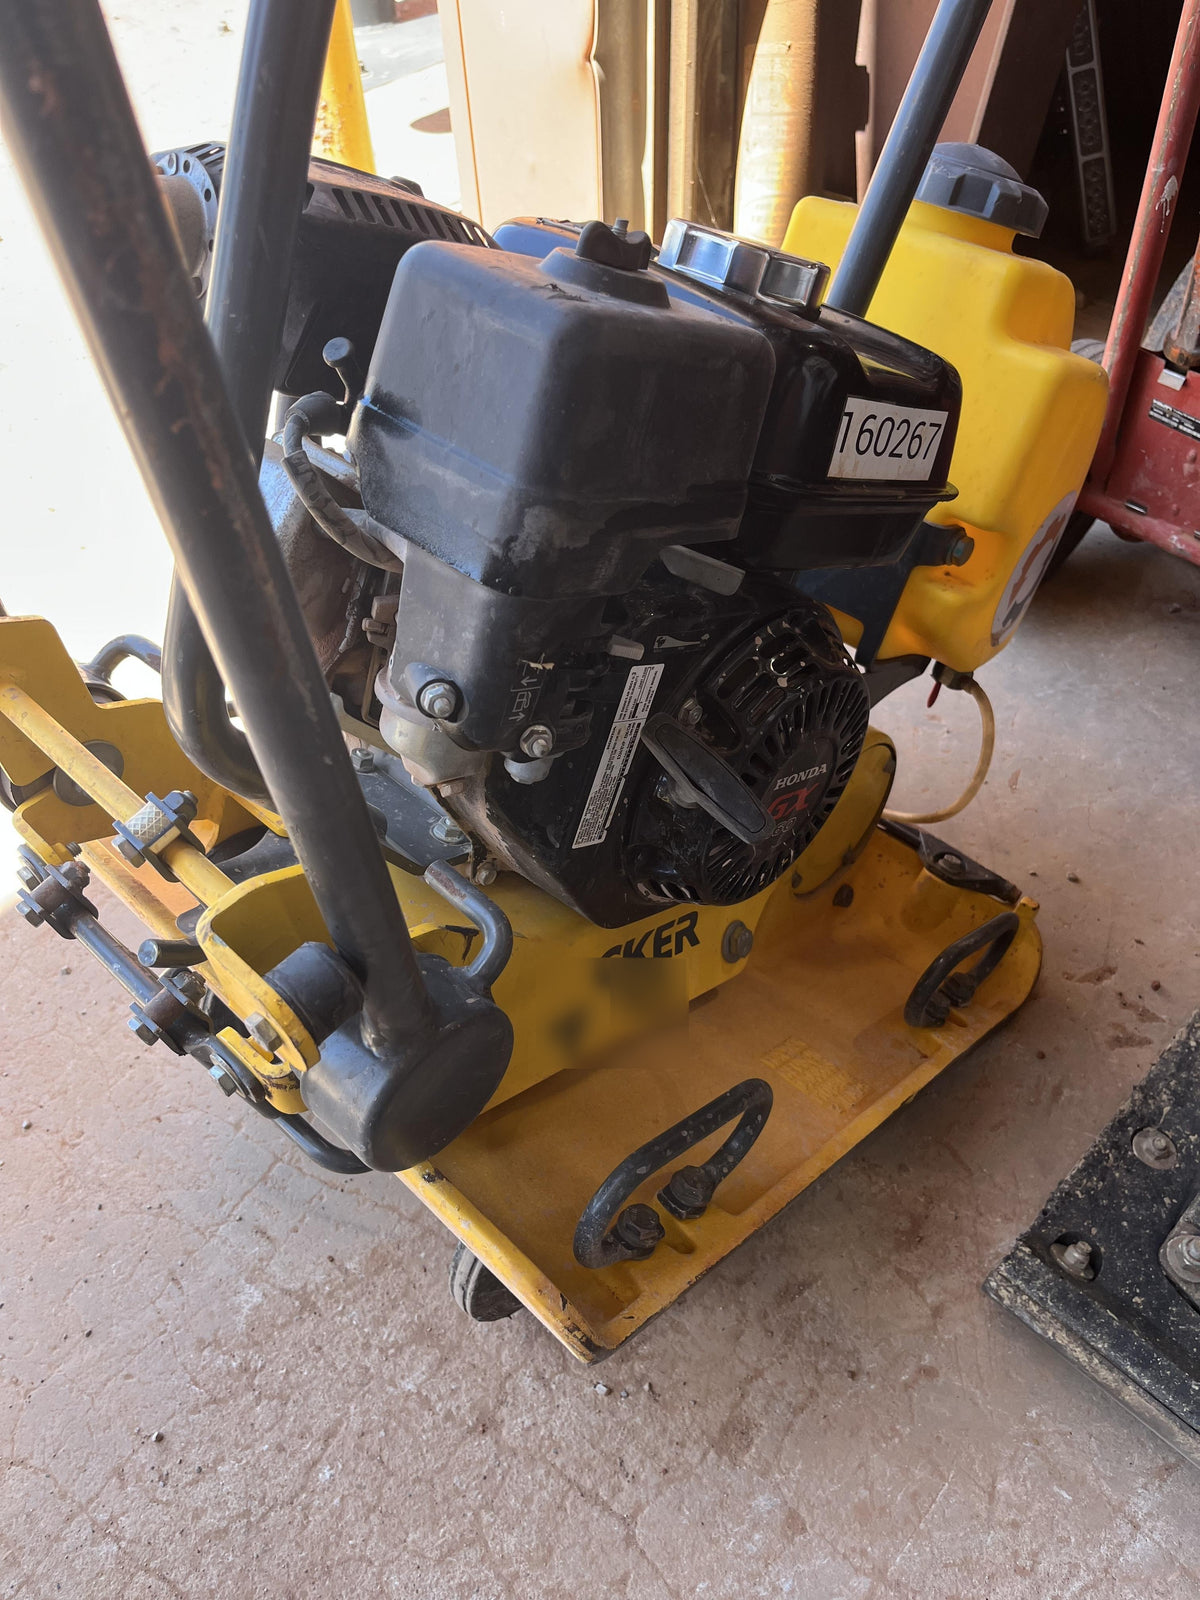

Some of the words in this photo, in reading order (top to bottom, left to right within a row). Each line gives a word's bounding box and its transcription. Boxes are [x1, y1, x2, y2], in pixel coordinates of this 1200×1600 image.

[839, 411, 942, 460] 160267
[773, 763, 827, 791] HONDA
[767, 782, 820, 820] GX
